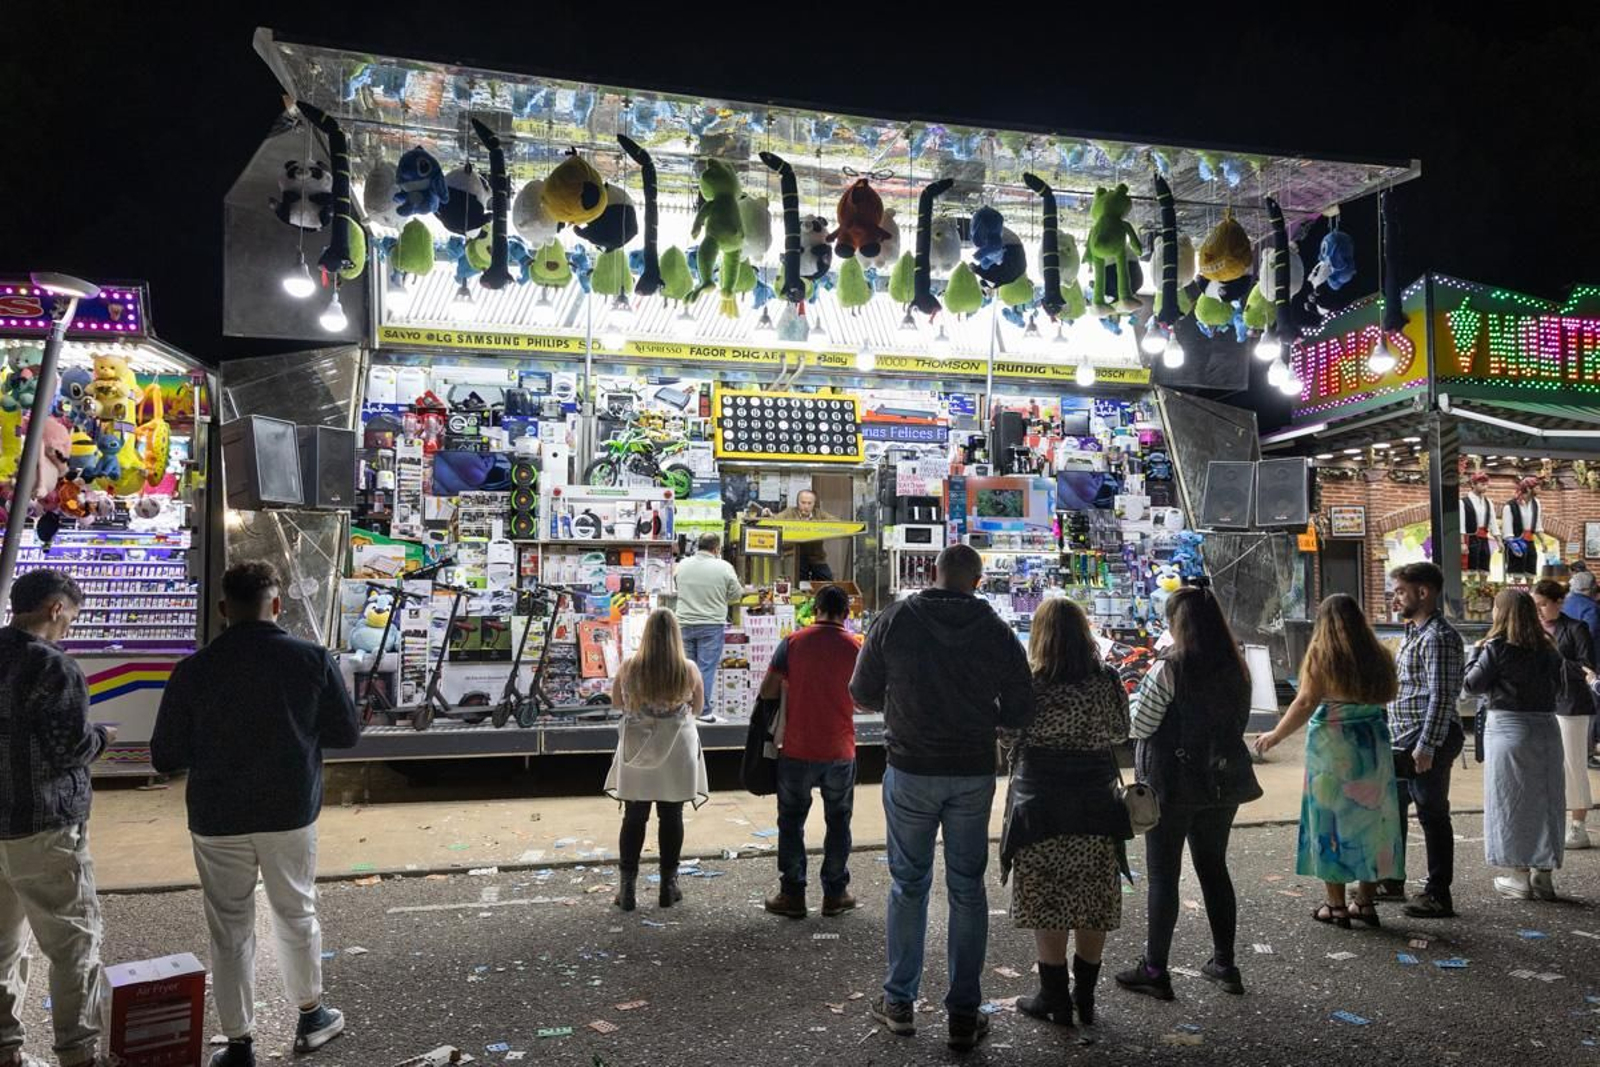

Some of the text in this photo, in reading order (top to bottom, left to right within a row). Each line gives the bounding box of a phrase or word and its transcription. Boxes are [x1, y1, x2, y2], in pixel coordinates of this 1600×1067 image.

[384, 330, 421, 341] SANYO
[436, 333, 452, 343] LG
[457, 334, 520, 346] SAMSUNG
[527, 338, 570, 349] PHILIPS
[689, 347, 726, 358] FAGOR
[915, 359, 981, 371] THOMSON
[992, 363, 1046, 374] GRUNDIG
[1098, 369, 1125, 378] BOSCH
[1291, 326, 1415, 401] VINOS
[890, 426, 933, 439] Felices
[136, 981, 179, 996] Air Fryer
